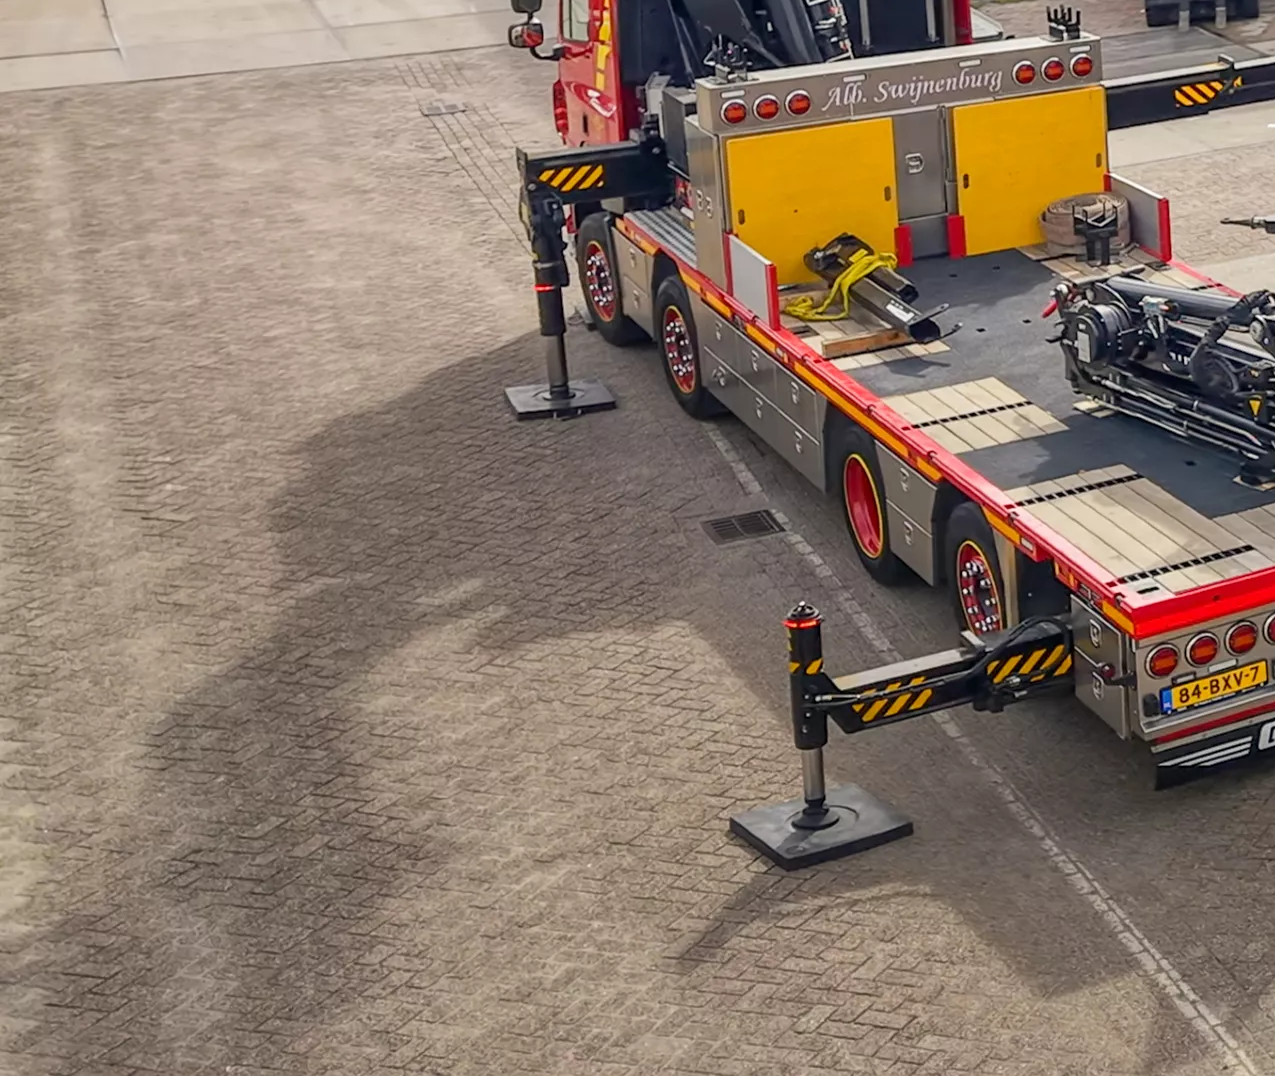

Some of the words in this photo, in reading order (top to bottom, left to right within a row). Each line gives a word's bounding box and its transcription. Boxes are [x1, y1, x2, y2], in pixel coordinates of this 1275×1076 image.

[821, 82, 867, 112] Alb.
[873, 67, 1003, 105] Swijnenburg
[1178, 665, 1260, 704] 84-BXV-7
